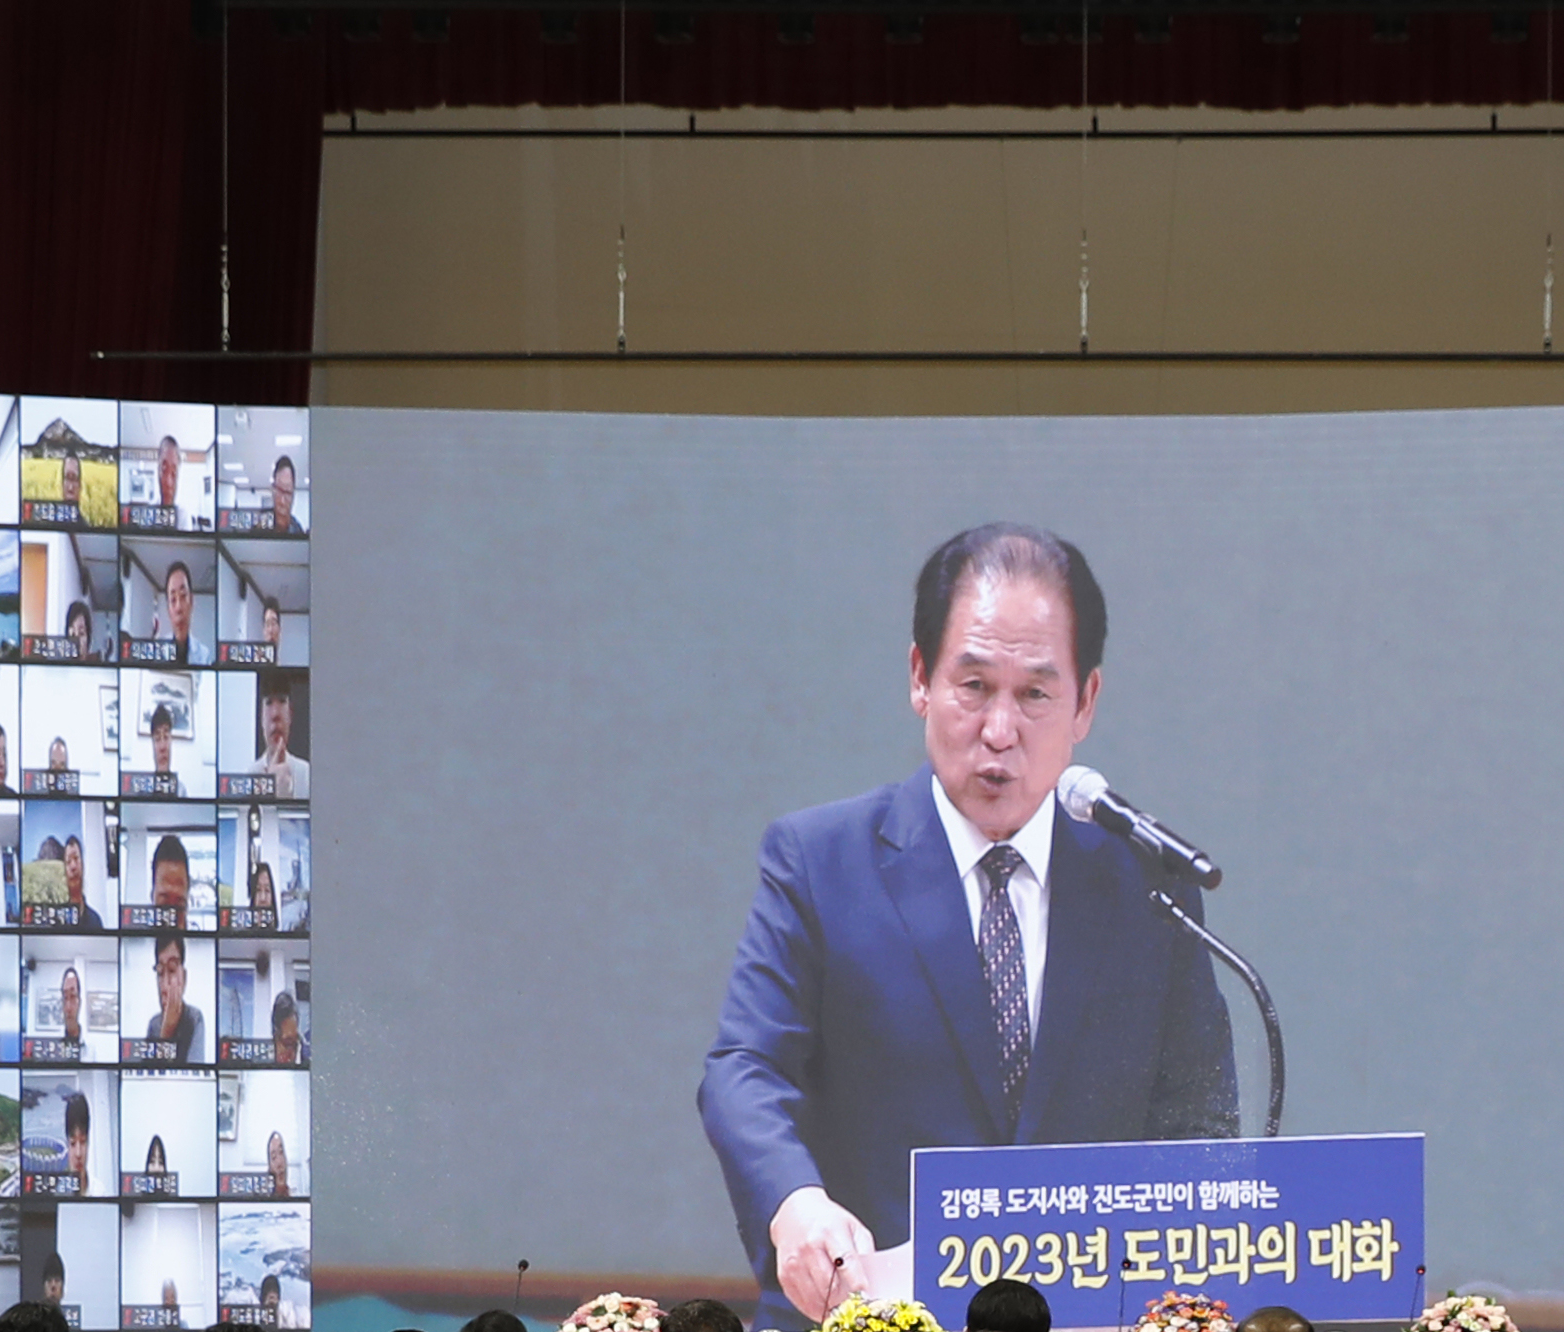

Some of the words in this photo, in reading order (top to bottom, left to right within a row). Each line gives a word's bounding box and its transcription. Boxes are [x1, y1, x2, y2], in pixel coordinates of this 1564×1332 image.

[939, 1188, 1003, 1219] 김영록
[1005, 1184, 1088, 1216] 도지사와
[1092, 1181, 1194, 1214] 진도군민이
[1198, 1179, 1280, 1212] 함께하는
[937, 1226, 1109, 1290] 2023년
[1121, 1220, 1296, 1288] 도민과의
[1306, 1217, 1400, 1284] 대화
